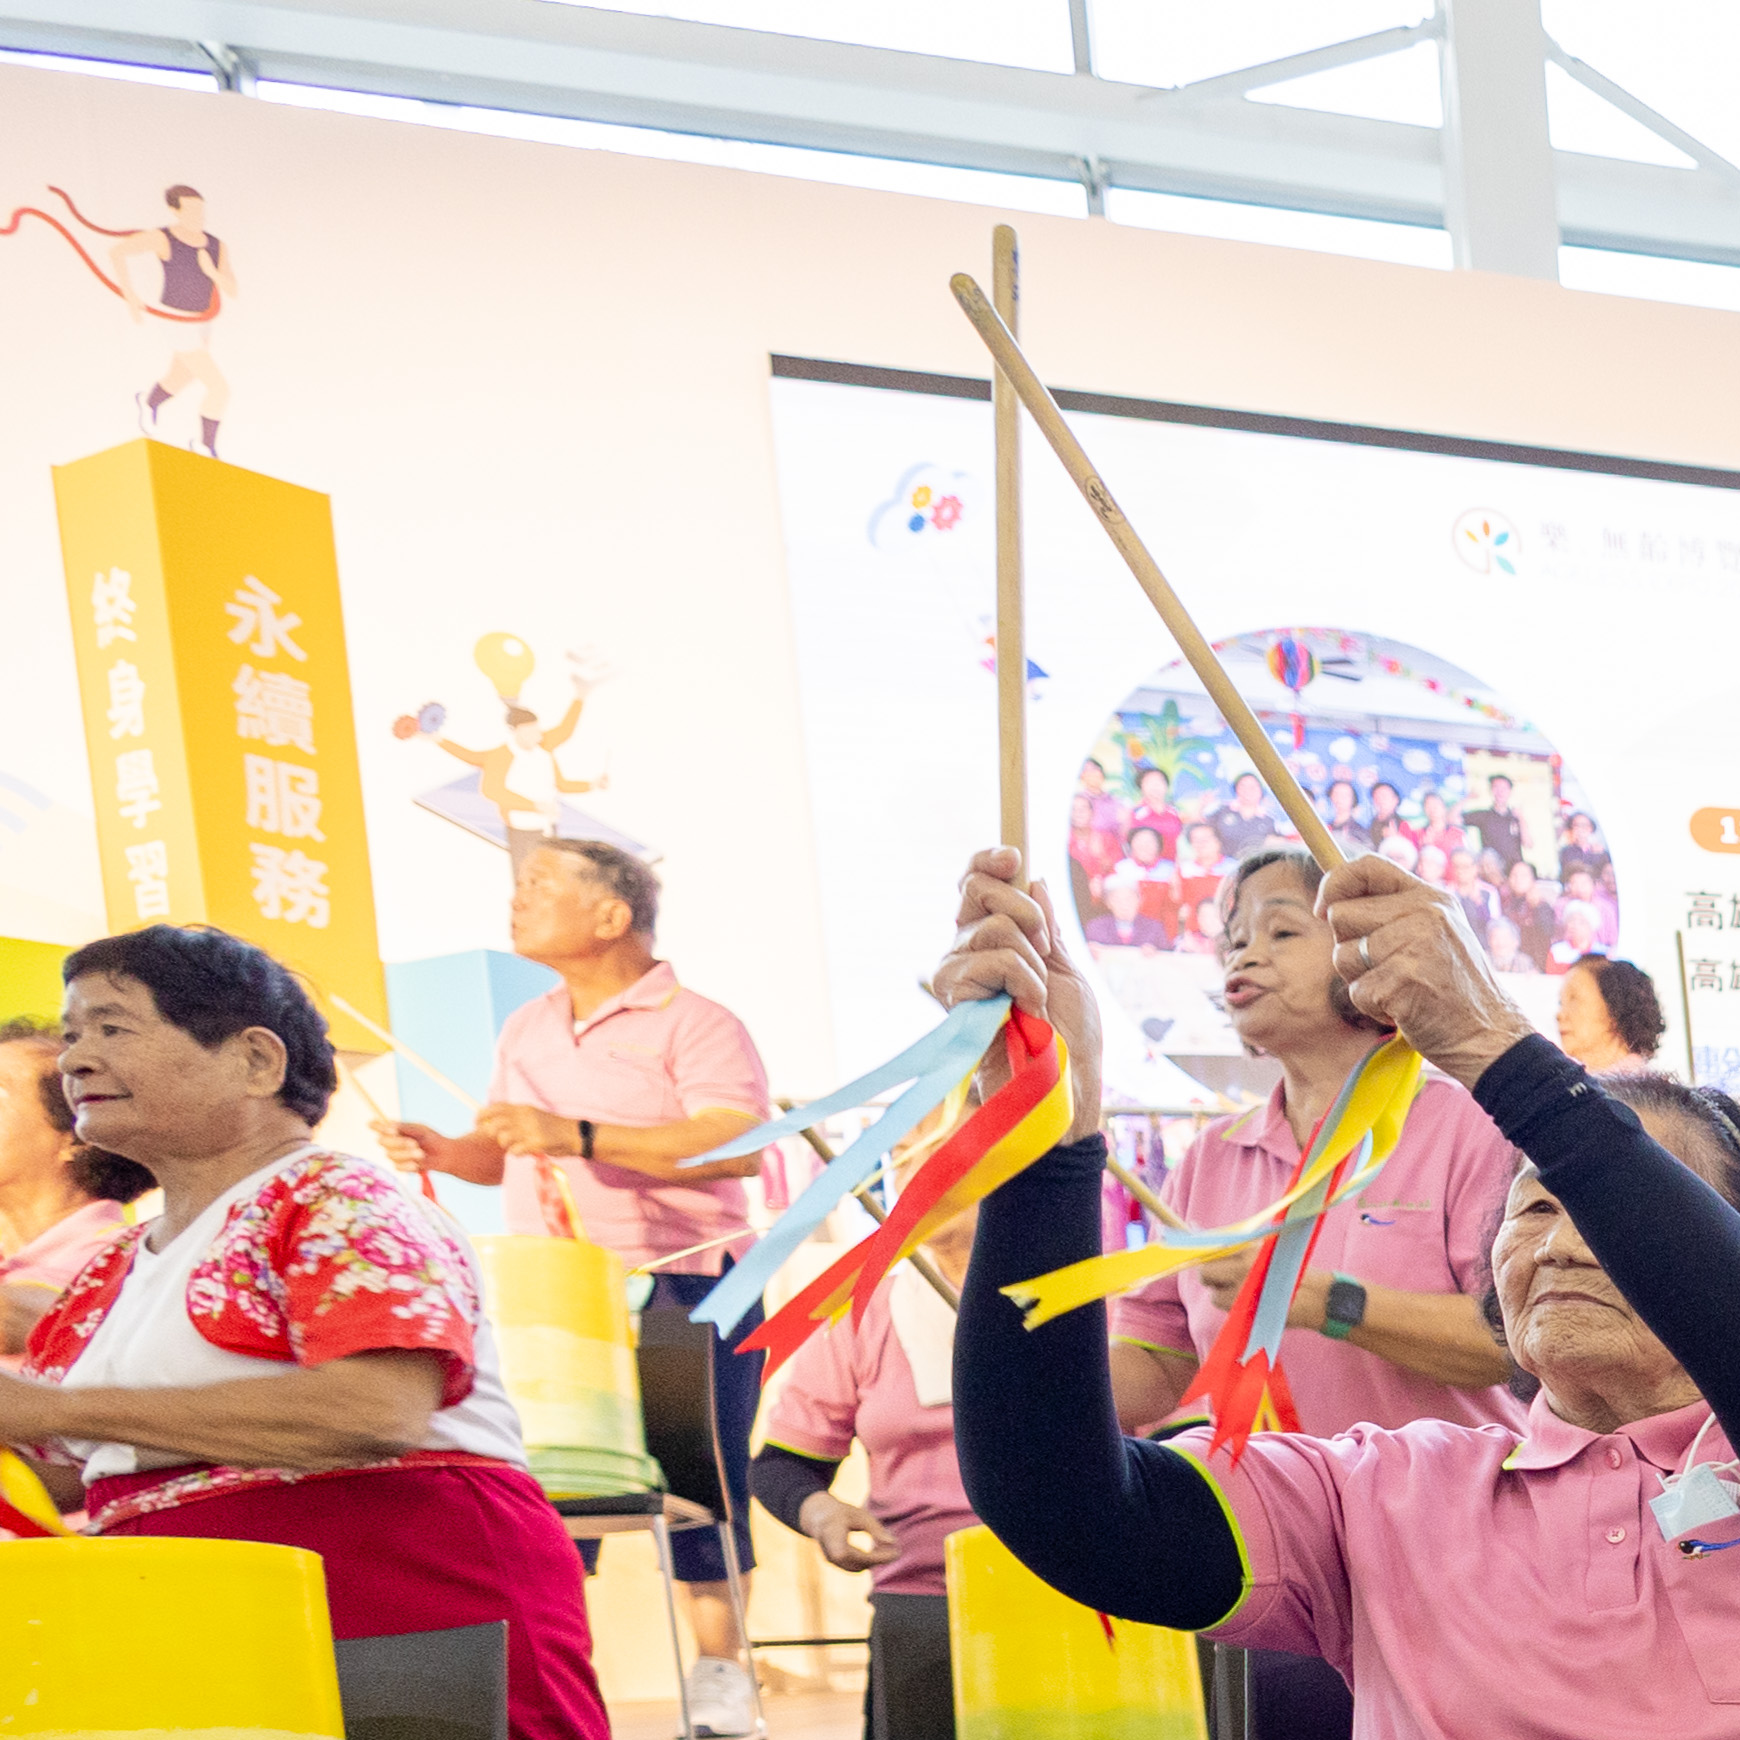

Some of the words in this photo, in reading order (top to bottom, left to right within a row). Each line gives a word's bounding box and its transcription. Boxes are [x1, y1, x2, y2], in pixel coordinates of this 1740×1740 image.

[91, 566, 170, 919] 終身學習
[226, 574, 330, 929] 永續服務
